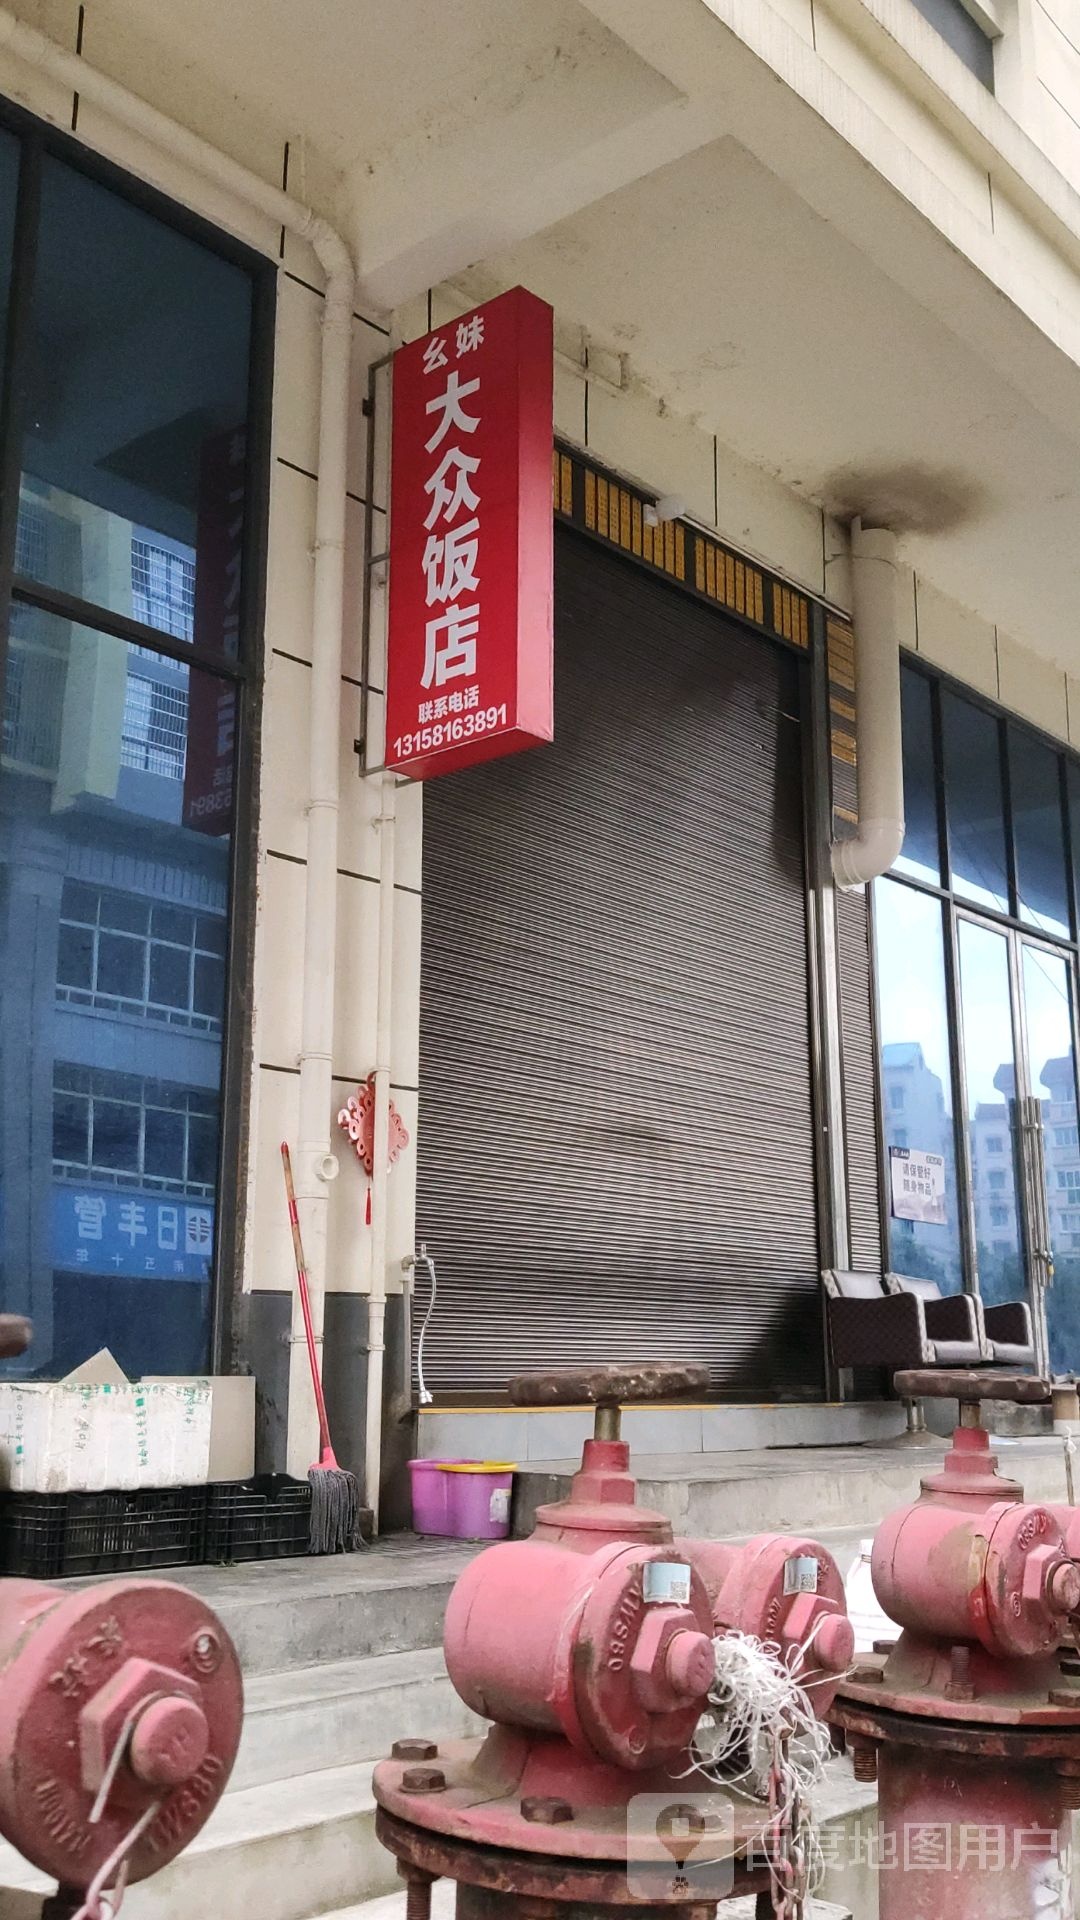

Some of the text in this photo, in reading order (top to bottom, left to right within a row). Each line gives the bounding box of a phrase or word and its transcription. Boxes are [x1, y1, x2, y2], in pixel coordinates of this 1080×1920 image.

[423, 314, 485, 375] 幺妹
[419, 369, 481, 689] 大众饭店
[394, 703, 507, 757] 13158163891
[418, 685, 480, 724] 联系电话
